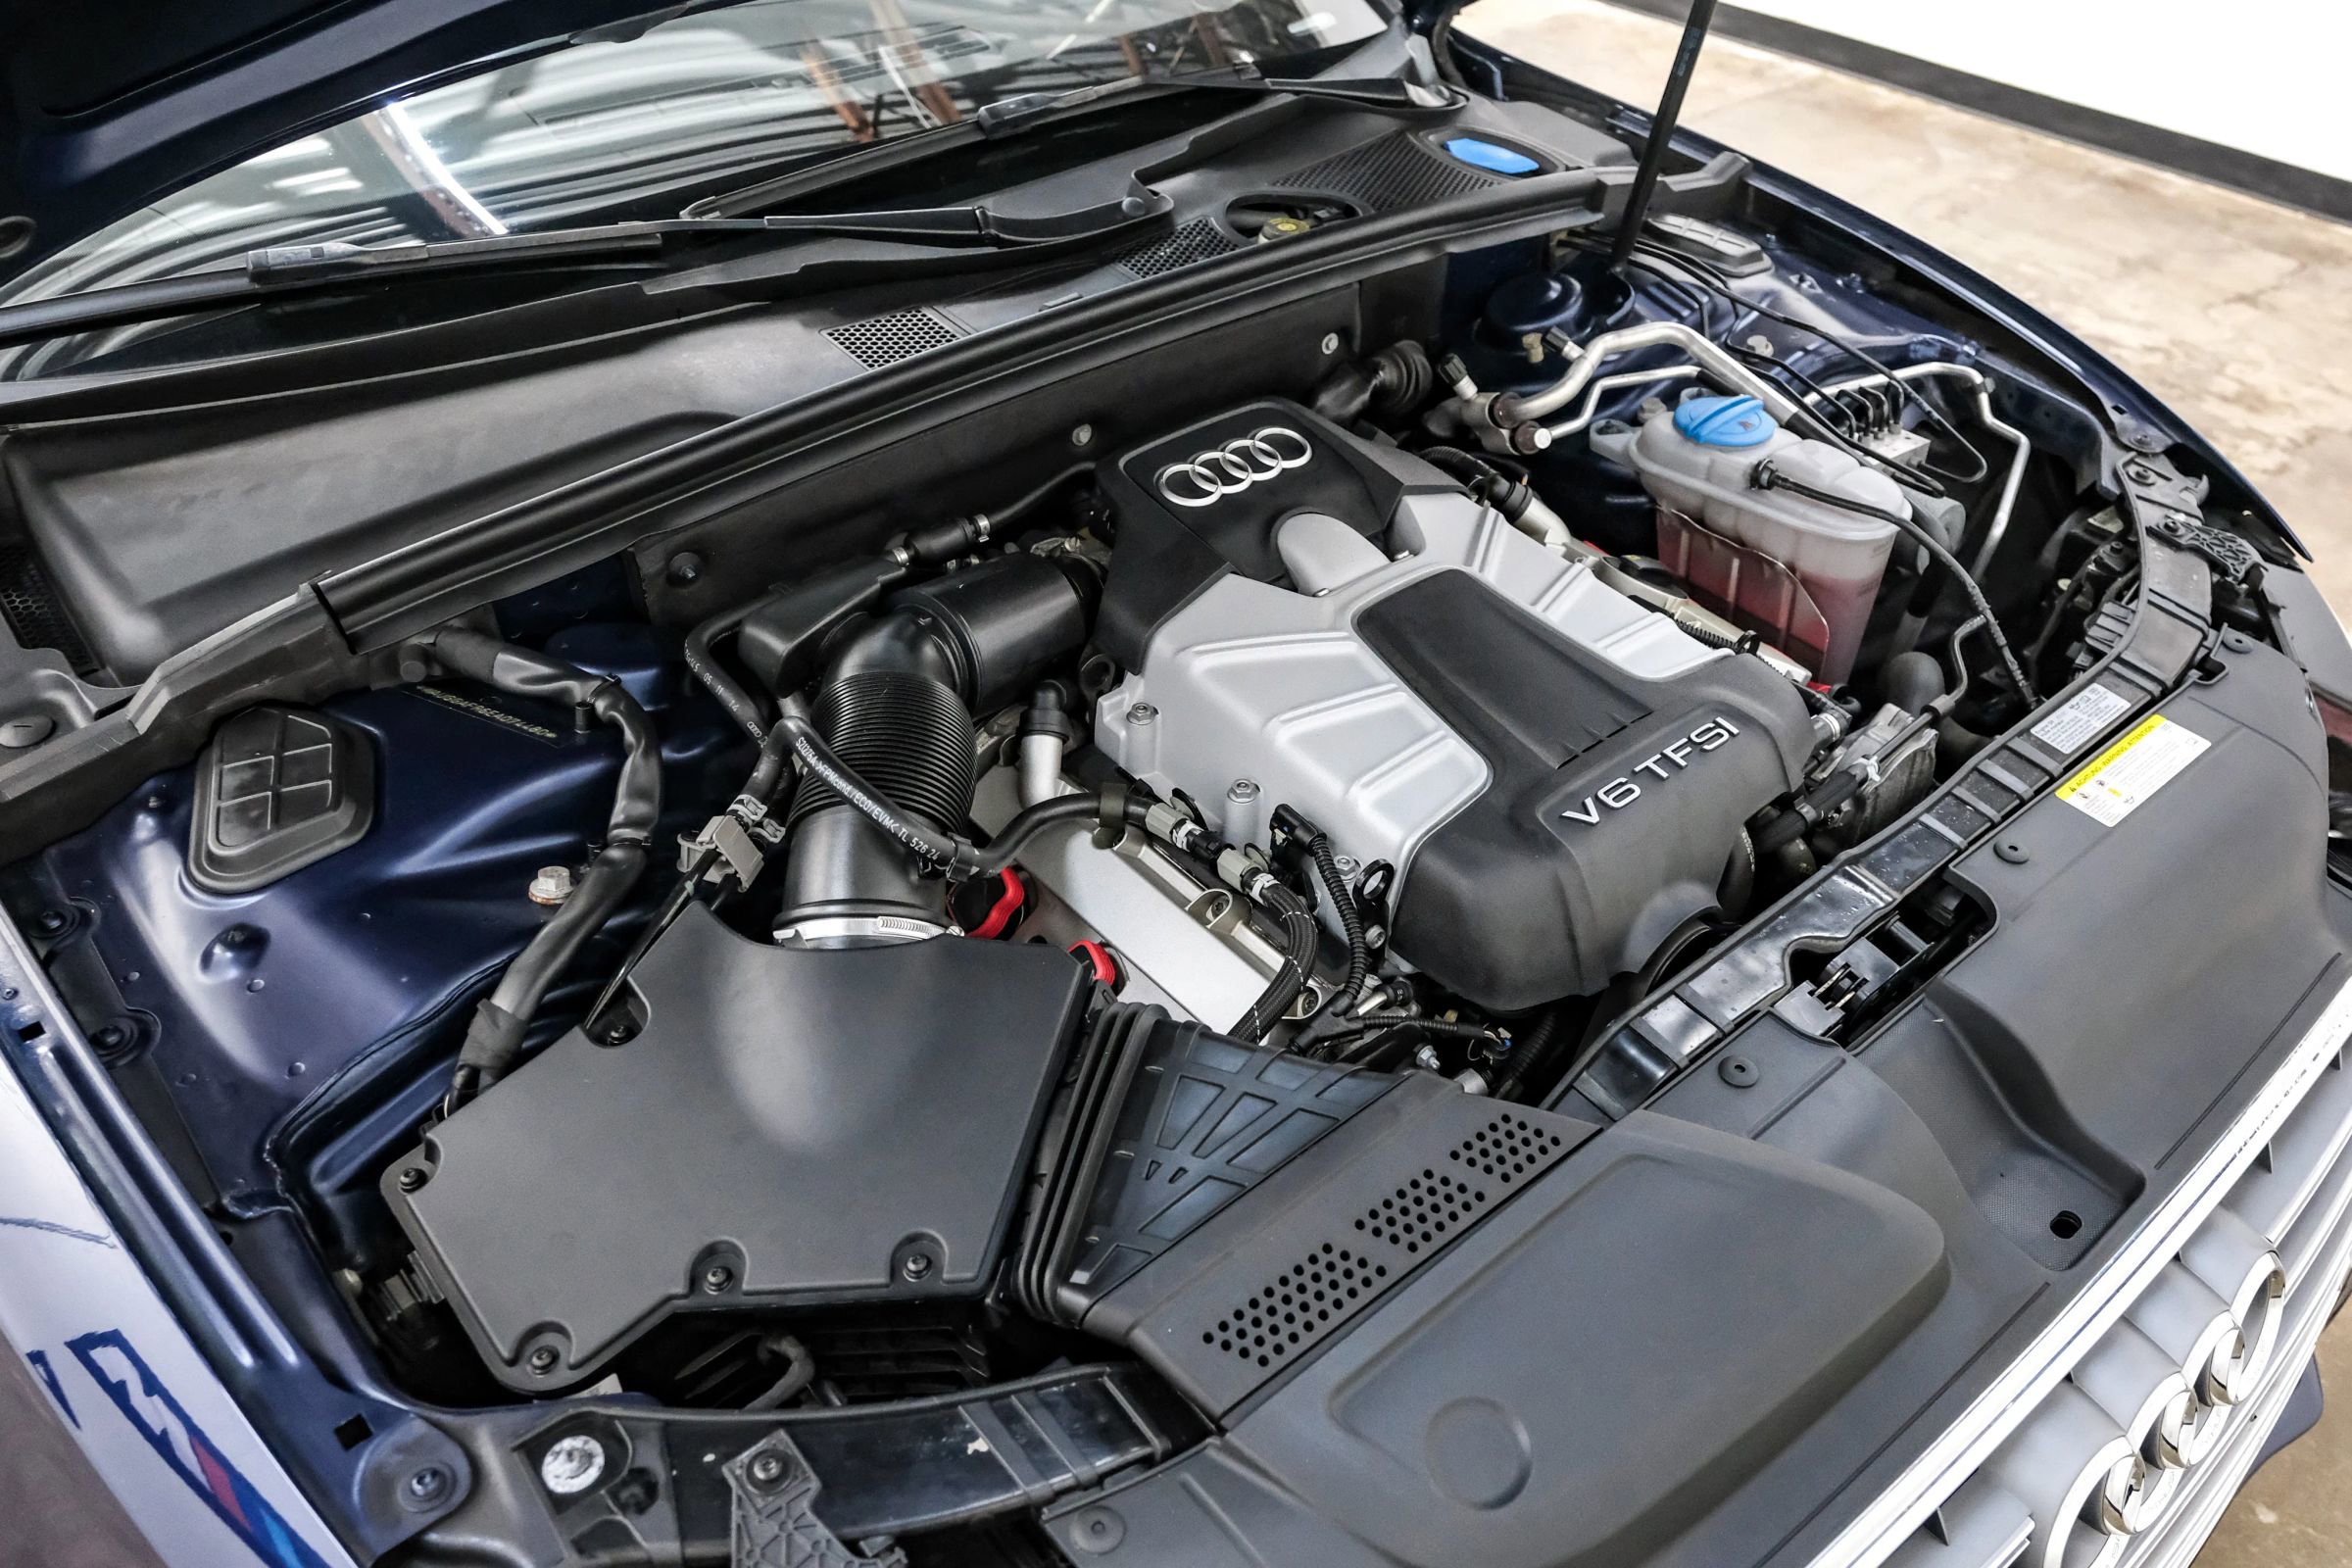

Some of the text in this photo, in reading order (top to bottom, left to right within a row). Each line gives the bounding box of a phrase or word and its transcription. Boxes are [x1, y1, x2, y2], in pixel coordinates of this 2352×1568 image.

[1560, 716, 1740, 825] V6 TFSI
[897, 827, 909, 843] TL
[909, 837, 929, 854] 526
